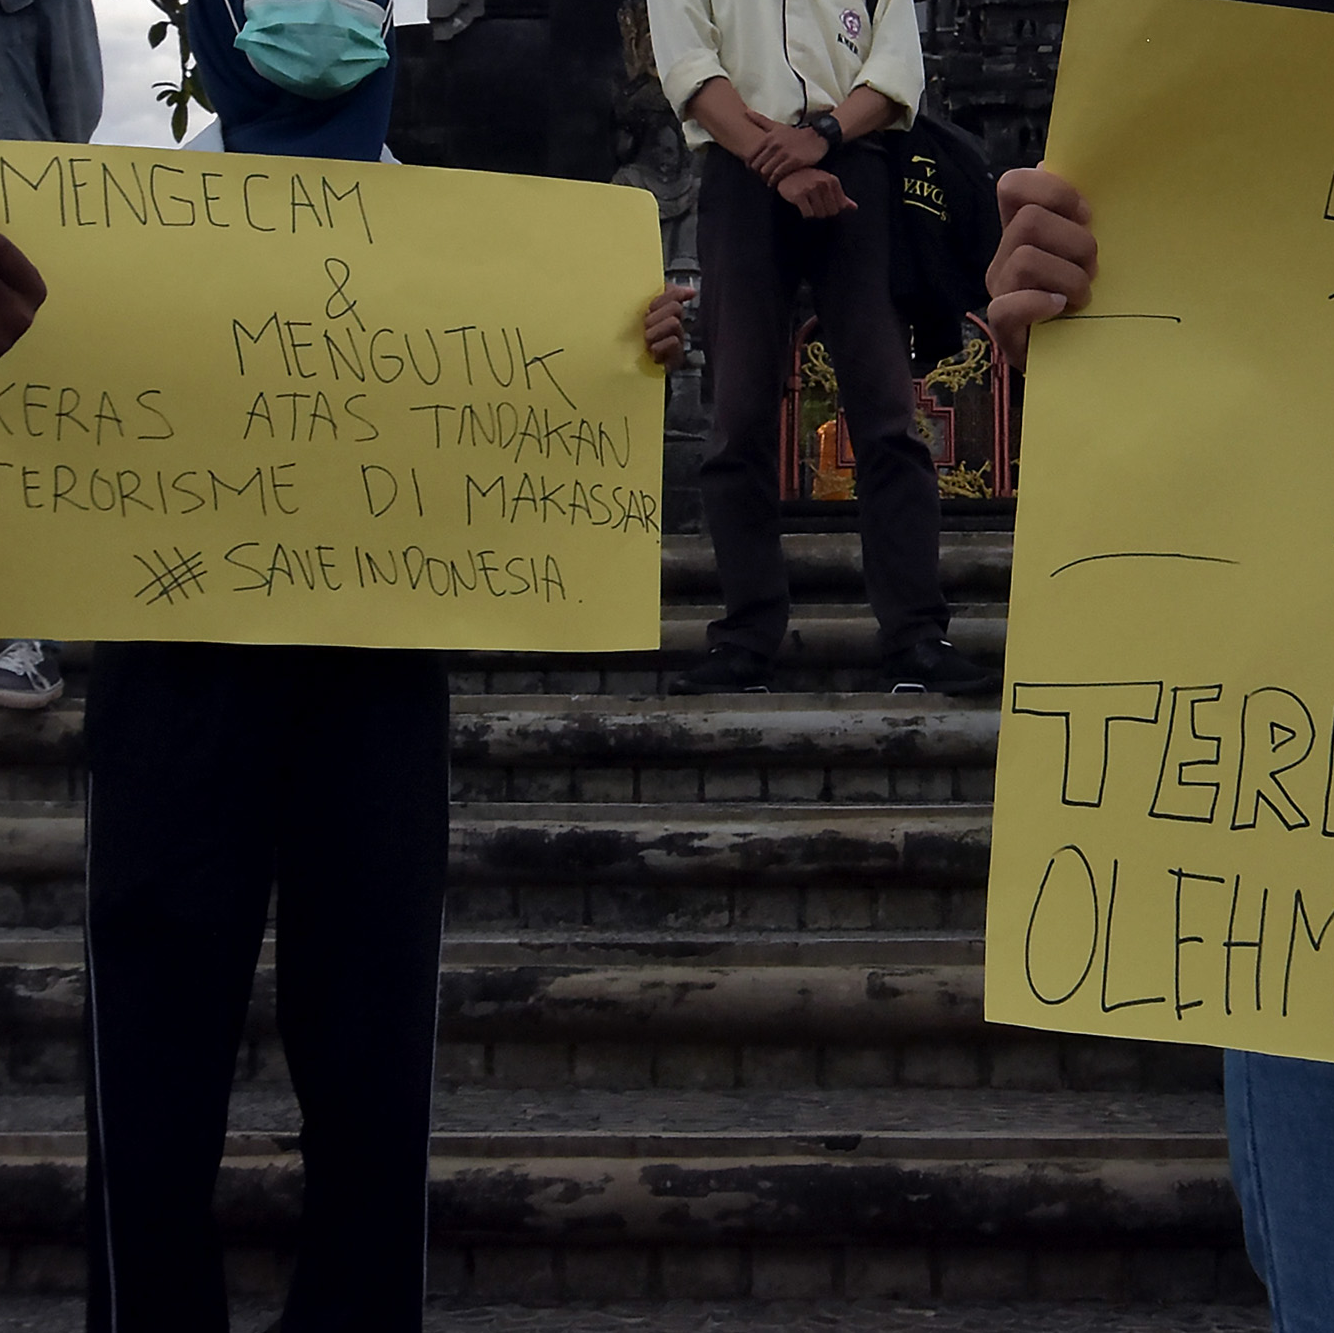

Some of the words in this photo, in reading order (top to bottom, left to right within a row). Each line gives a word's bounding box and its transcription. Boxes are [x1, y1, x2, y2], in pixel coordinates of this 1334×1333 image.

[0, 155, 373, 243] MENGECAM
[323, 257, 366, 332] &
[232, 312, 576, 409] MENGUTUK
[244, 390, 379, 442] ATAS
[410, 403, 629, 468] TINDAKAN
[361, 465, 423, 518] DI
